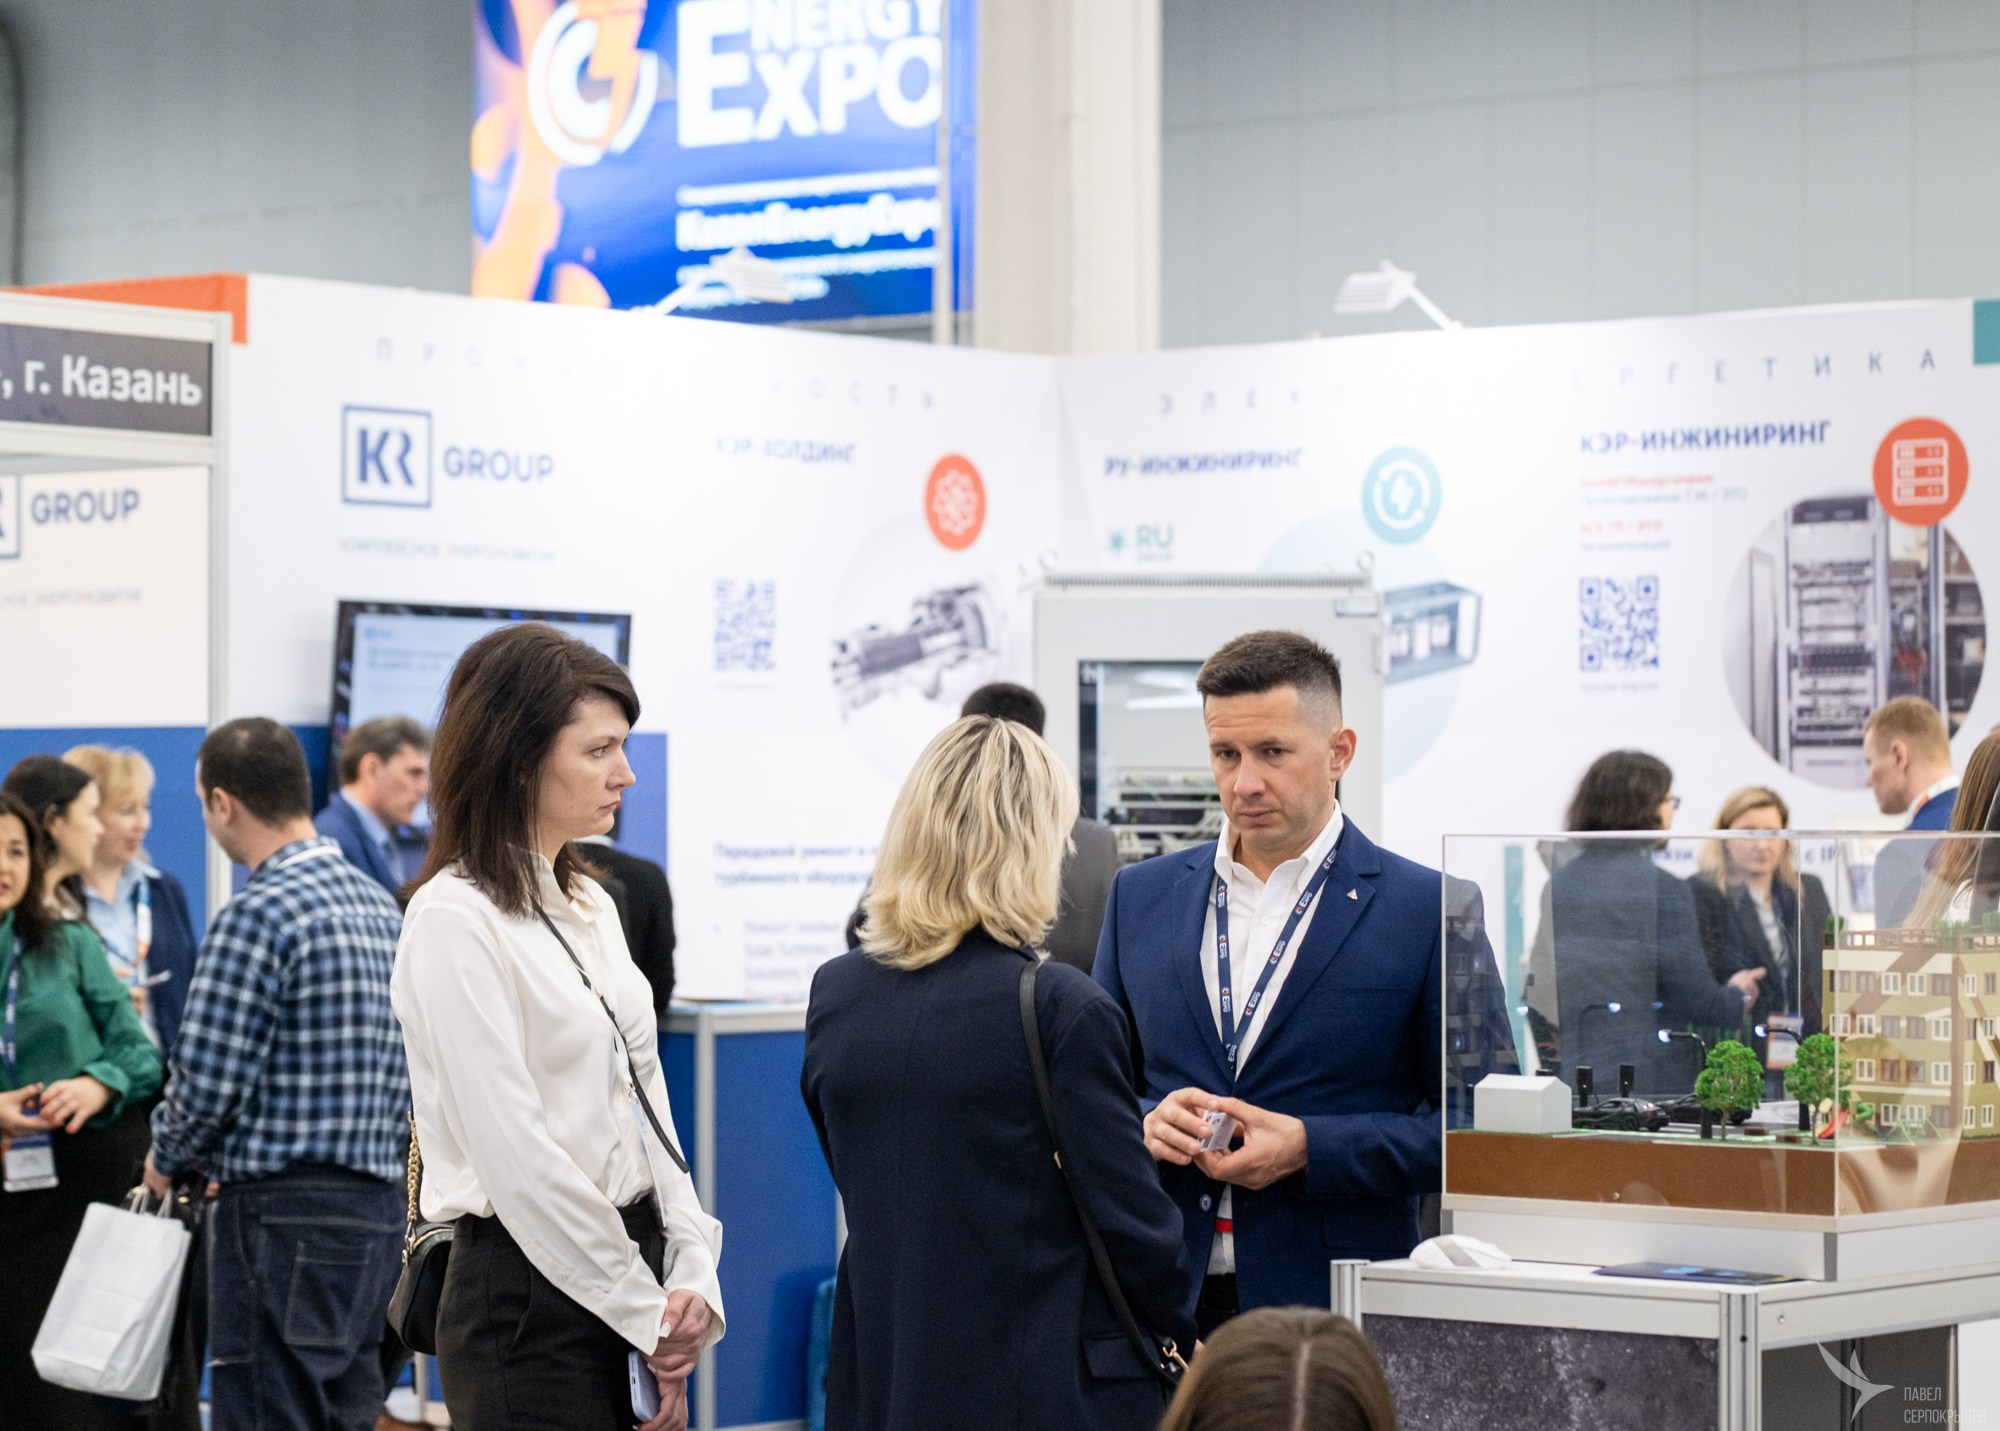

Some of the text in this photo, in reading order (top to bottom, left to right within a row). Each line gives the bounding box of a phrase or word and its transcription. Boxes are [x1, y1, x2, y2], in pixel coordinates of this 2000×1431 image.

[24, 360, 51, 395] г.
[62, 354, 203, 406] Казань
[1580, 420, 1831, 454] КЭР-ИНЖИНИРИНГ
[443, 446, 555, 482] GROUP
[31, 488, 140, 525] GROUP
